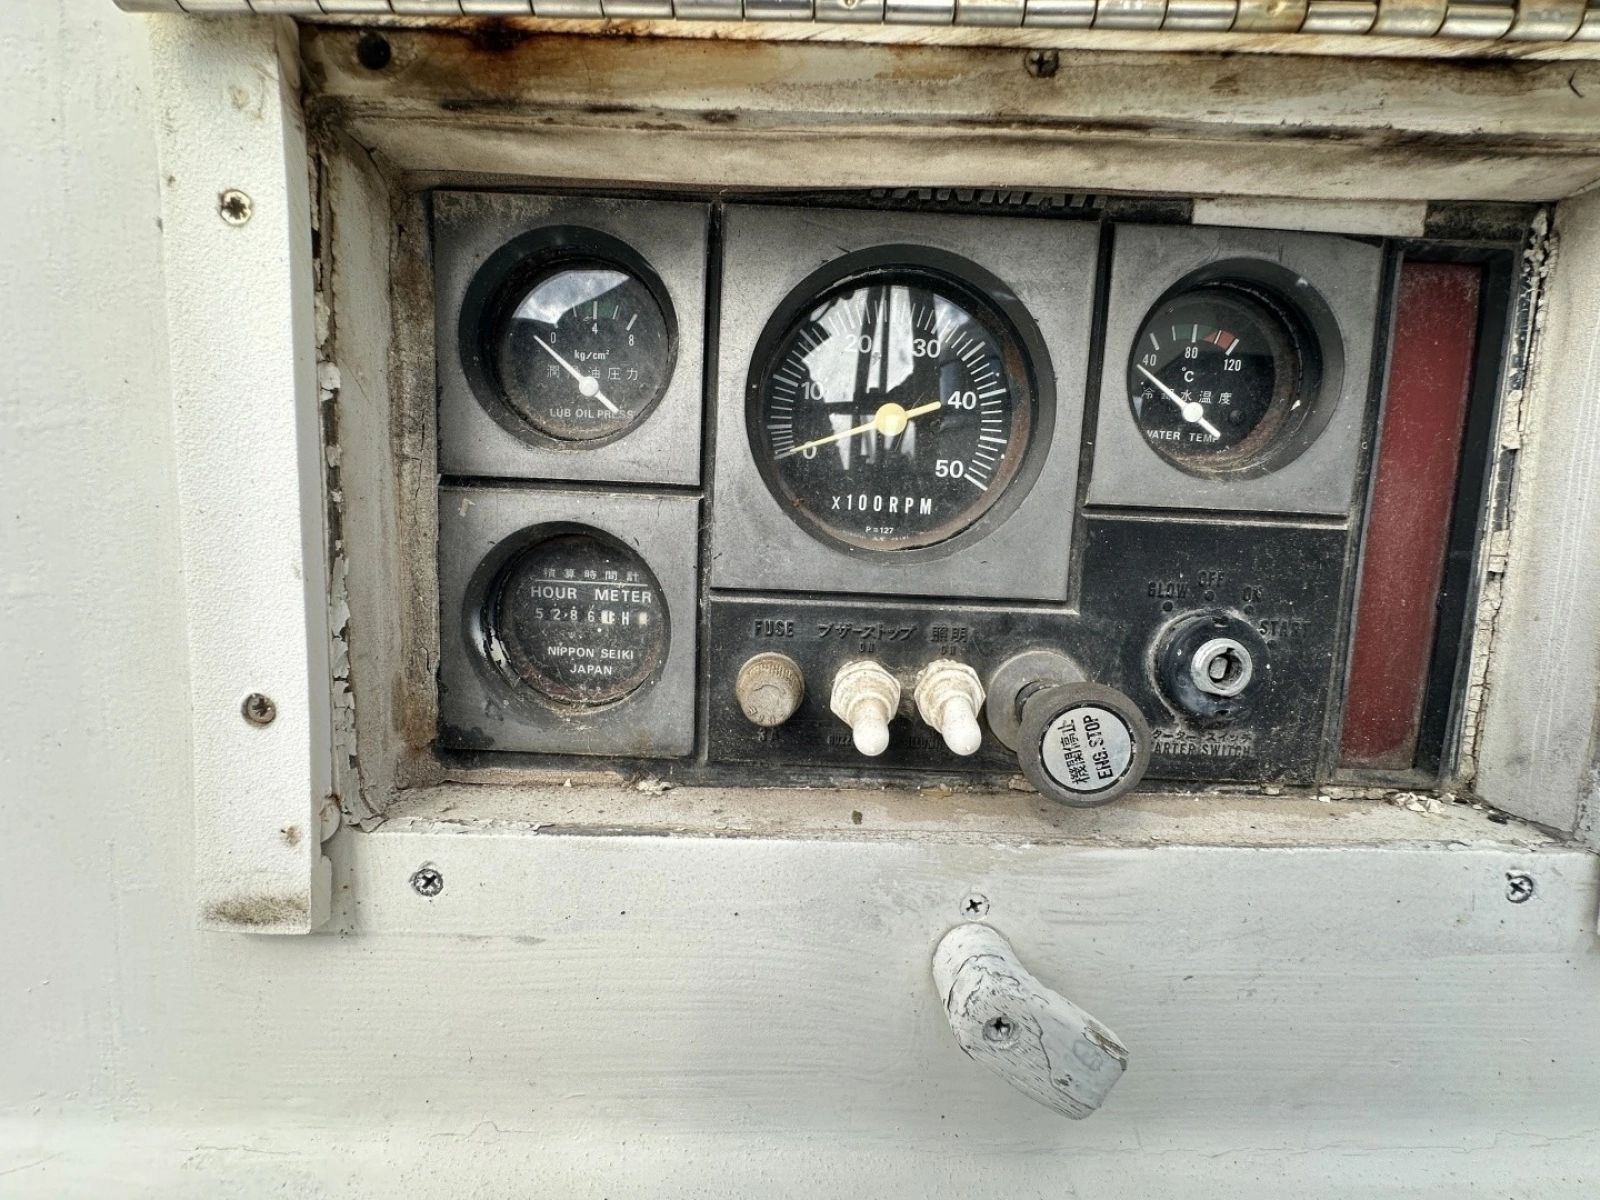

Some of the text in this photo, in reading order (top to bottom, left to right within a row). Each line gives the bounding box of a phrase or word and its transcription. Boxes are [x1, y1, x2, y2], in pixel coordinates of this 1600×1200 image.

[591, 323, 598, 334] 4
[550, 332, 556, 343] 0
[628, 334, 634, 346] 8
[843, 334, 872, 353] 20
[913, 338, 941, 358] 30
[1184, 347, 1198, 358] 80
[1142, 354, 1156, 366] 40
[1223, 359, 1241, 371] 120
[801, 382, 824, 400] 10
[947, 391, 976, 410] 40
[550, 408, 571, 418] LUB
[576, 409, 594, 419] OIL
[802, 441, 817, 460] 0
[935, 460, 963, 478] 50
[1198, 571, 1225, 588] OFF
[531, 586, 651, 603] HOUR METER
[1148, 582, 1188, 599] GLOW
[754, 619, 794, 638] FUSE
[931, 626, 969, 643] 照明
[547, 646, 633, 660] NIPPON SEIKI
[570, 664, 612, 676] JAPAN
